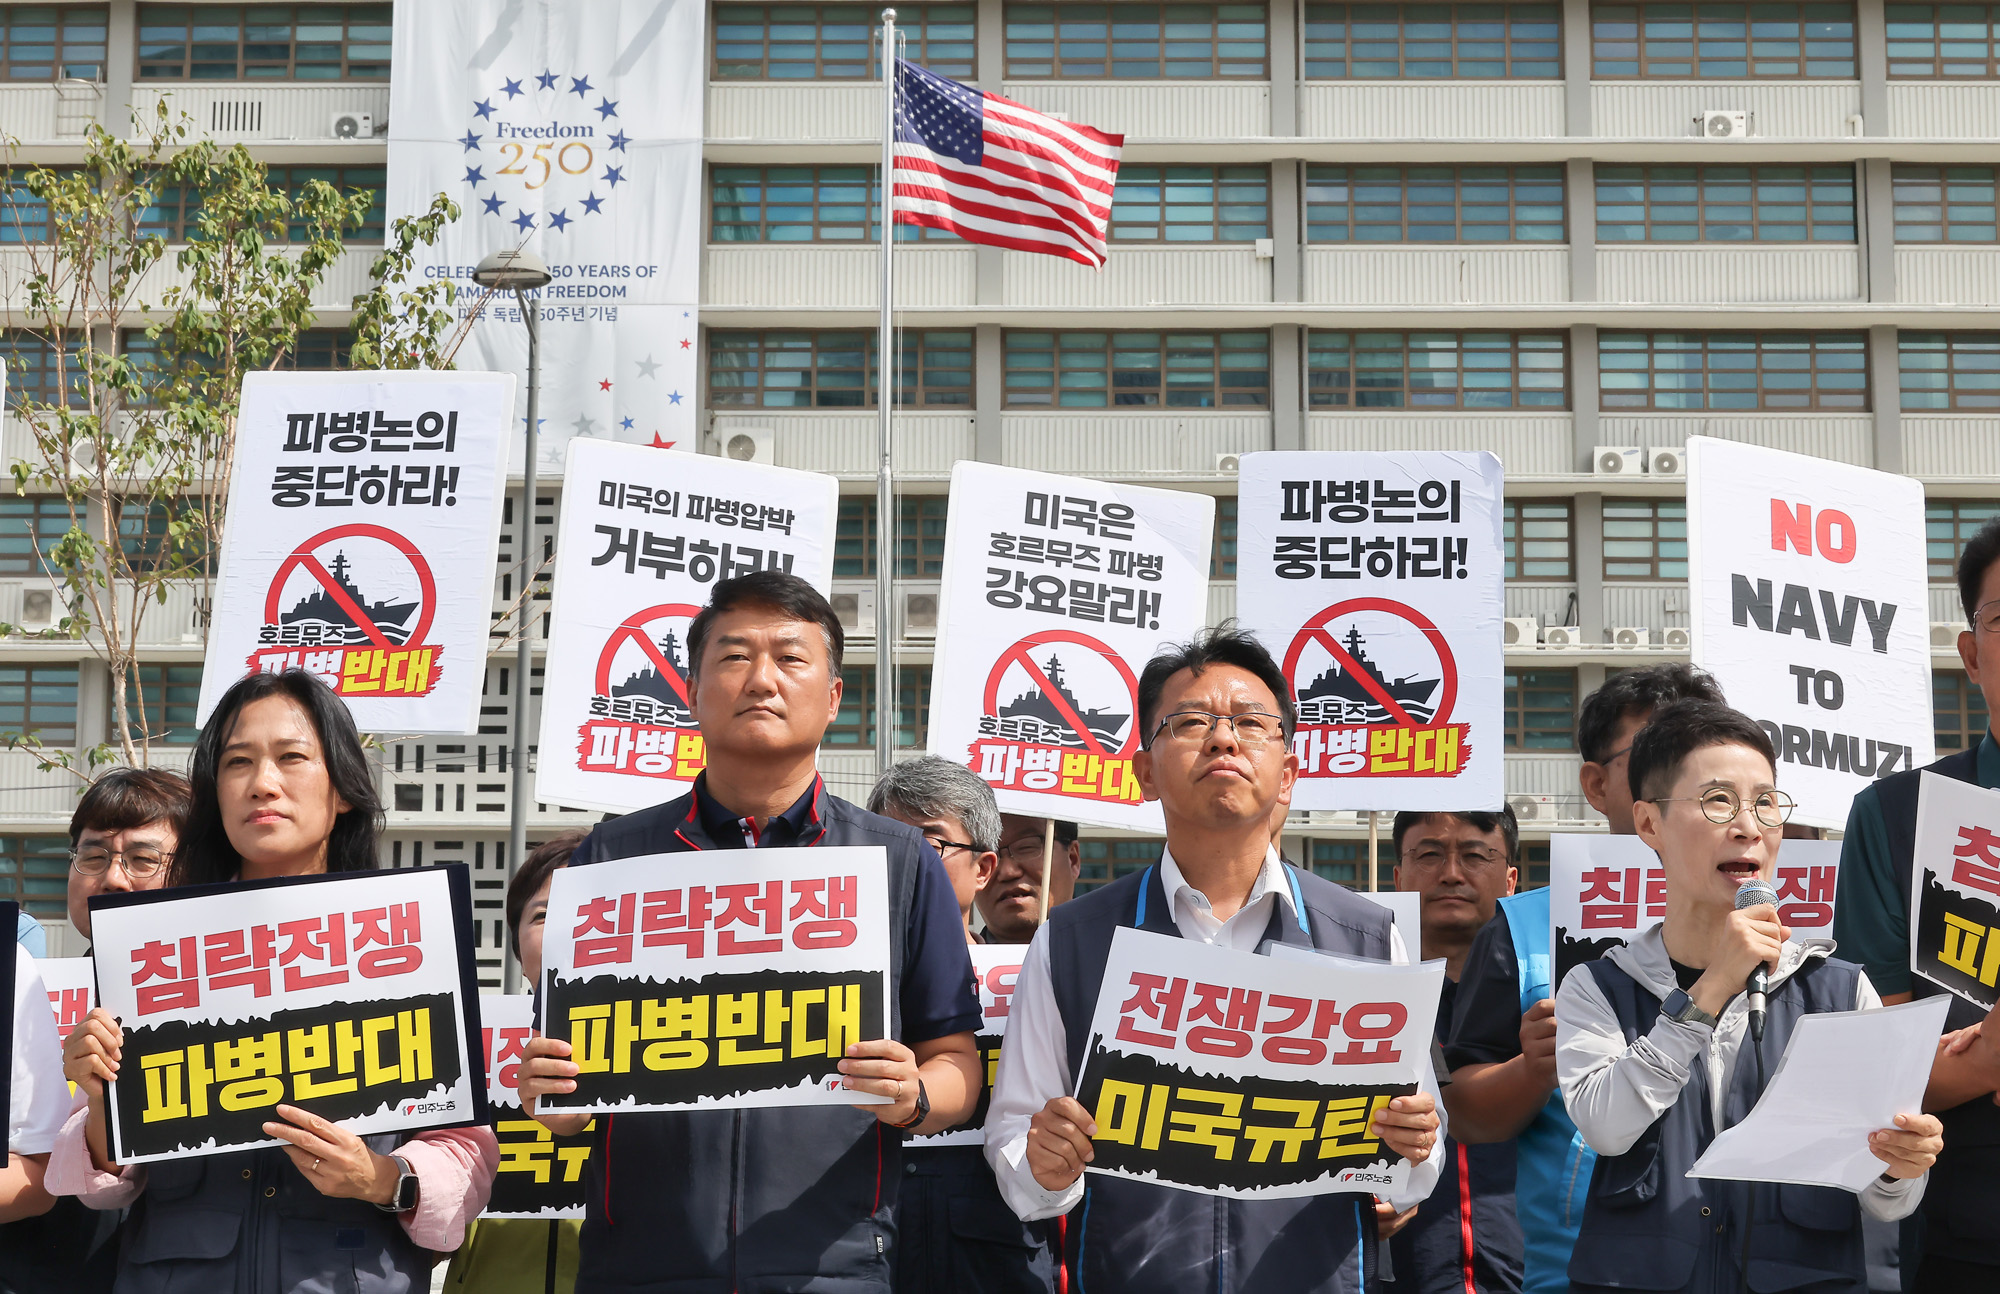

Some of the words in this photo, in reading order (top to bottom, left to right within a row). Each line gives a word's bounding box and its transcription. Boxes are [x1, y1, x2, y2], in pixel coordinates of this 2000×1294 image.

[496, 121, 594, 138] Freedom
[496, 142, 593, 190] 250
[547, 285, 627, 298] FREEDOM
[577, 265, 631, 278] YEARS
[635, 265, 658, 278] OF
[493, 306, 521, 322] 독립
[528, 306, 587, 322] 50주년
[589, 306, 618, 322] 기념
[283, 411, 459, 453] 파병논의
[272, 465, 460, 507] 중단하라!
[599, 480, 680, 517] 미국의
[686, 493, 795, 535] 파병압박
[1280, 480, 1460, 523] 파병논의
[1025, 491, 1135, 541] 미국은
[1771, 498, 1856, 564] NO
[988, 532, 1100, 572] 호르무즈
[1108, 549, 1163, 582] 파병
[1273, 536, 1468, 579] 중단하라!
[986, 567, 1162, 630] 강요말라!
[1732, 573, 1898, 654] NAVY
[258, 625, 345, 645] 호르무즈
[589, 696, 677, 725] 호르무즈
[1789, 664, 1844, 710] TO
[978, 717, 1062, 745] 호르무즈
[1294, 702, 1366, 723] 르무즈
[586, 726, 707, 776] 파병반
[977, 745, 1144, 801] 파병반대
[572, 876, 858, 968] 침략전쟁
[130, 901, 424, 1017] 침략전쟁
[568, 983, 861, 1074] 파병반대
[1115, 971, 1408, 1065] 전쟁강요
[140, 1007, 433, 1123] 파병반대
[417, 1100, 456, 1114] 민주노총
[1092, 1078, 1391, 1163] 미국규탄
[1355, 1173, 1393, 1185] 민주노총
